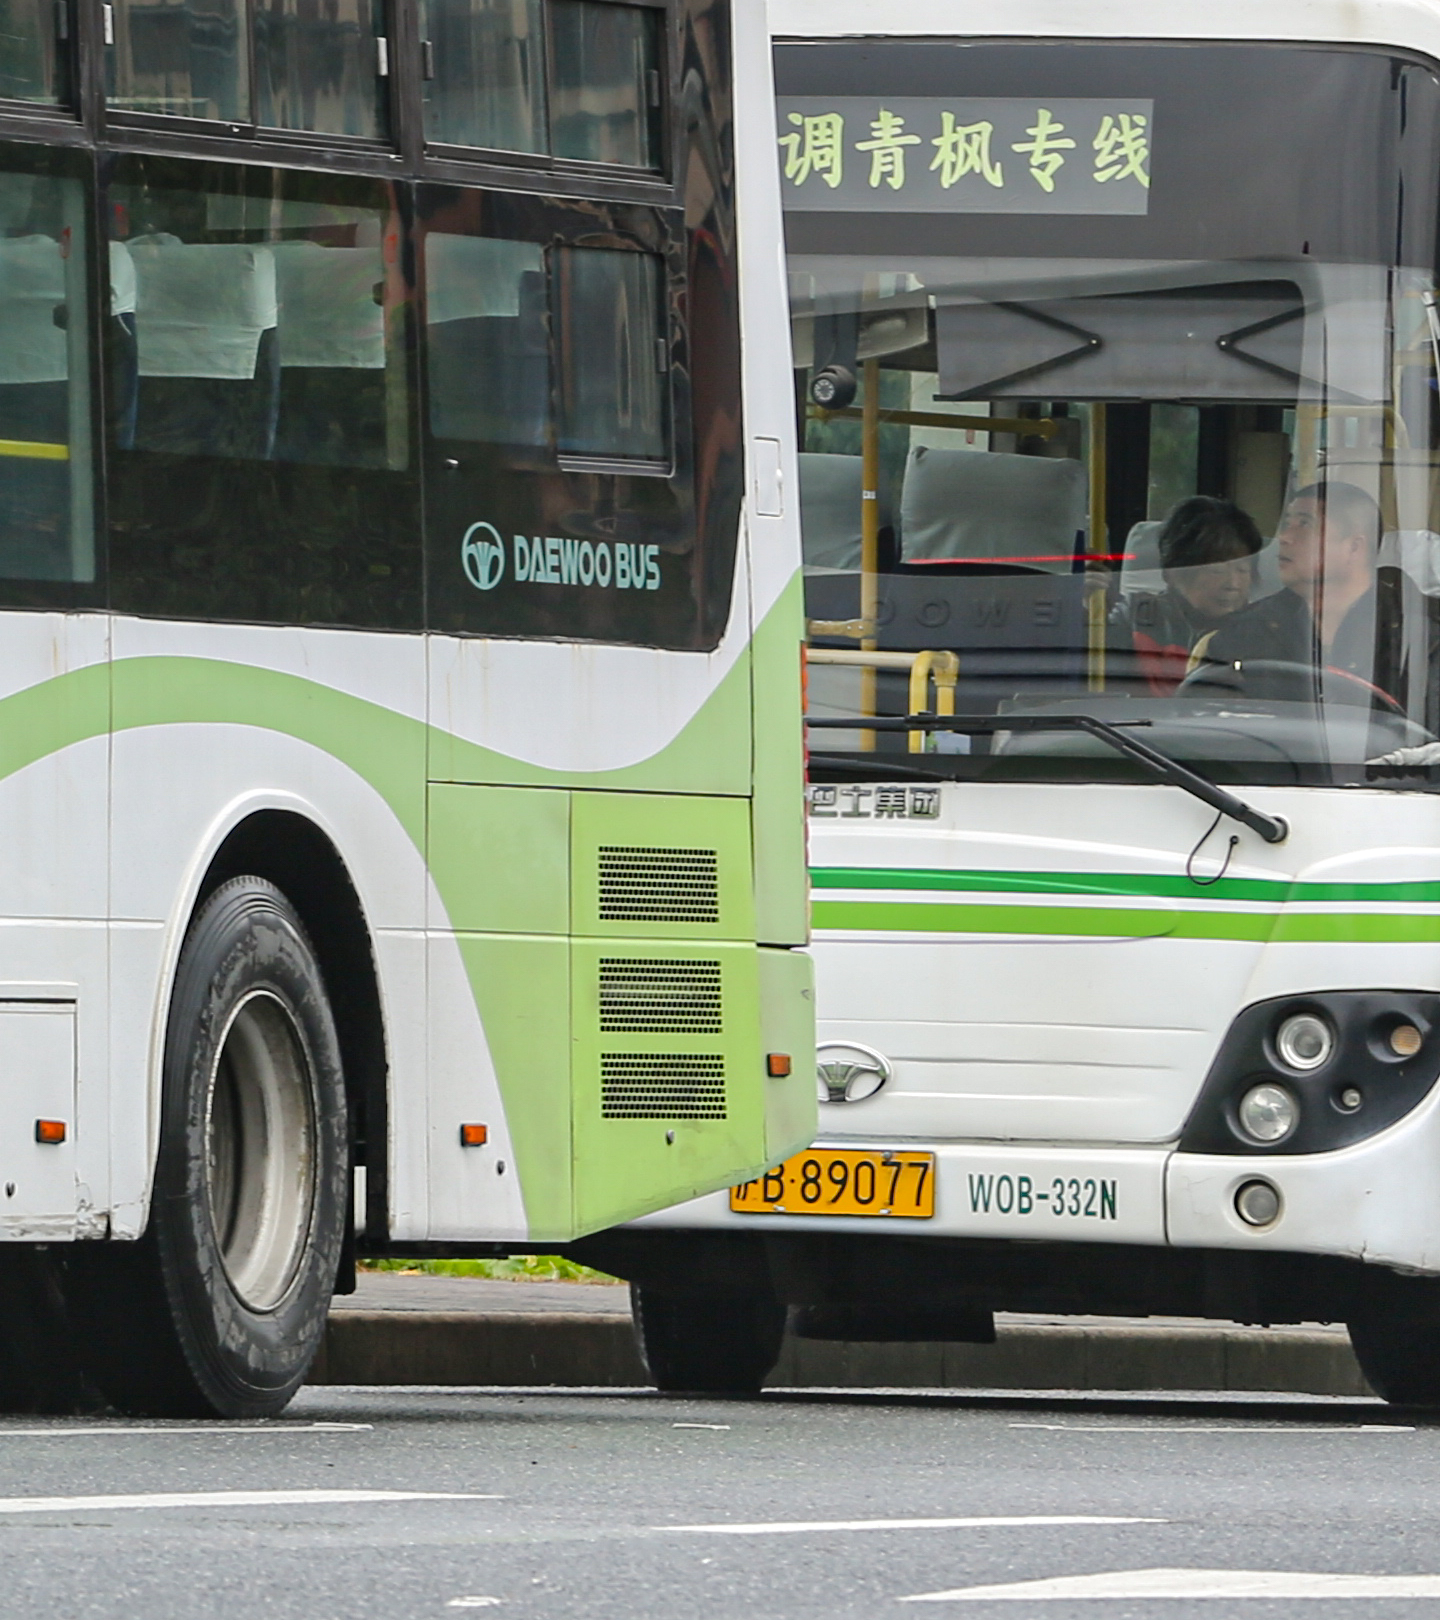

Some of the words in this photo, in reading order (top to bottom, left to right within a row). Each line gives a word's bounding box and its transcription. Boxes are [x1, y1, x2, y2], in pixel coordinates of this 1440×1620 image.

[778, 108, 1151, 192] 调青枫专线
[514, 535, 612, 588] DAEWOO
[615, 543, 661, 590] BUS
